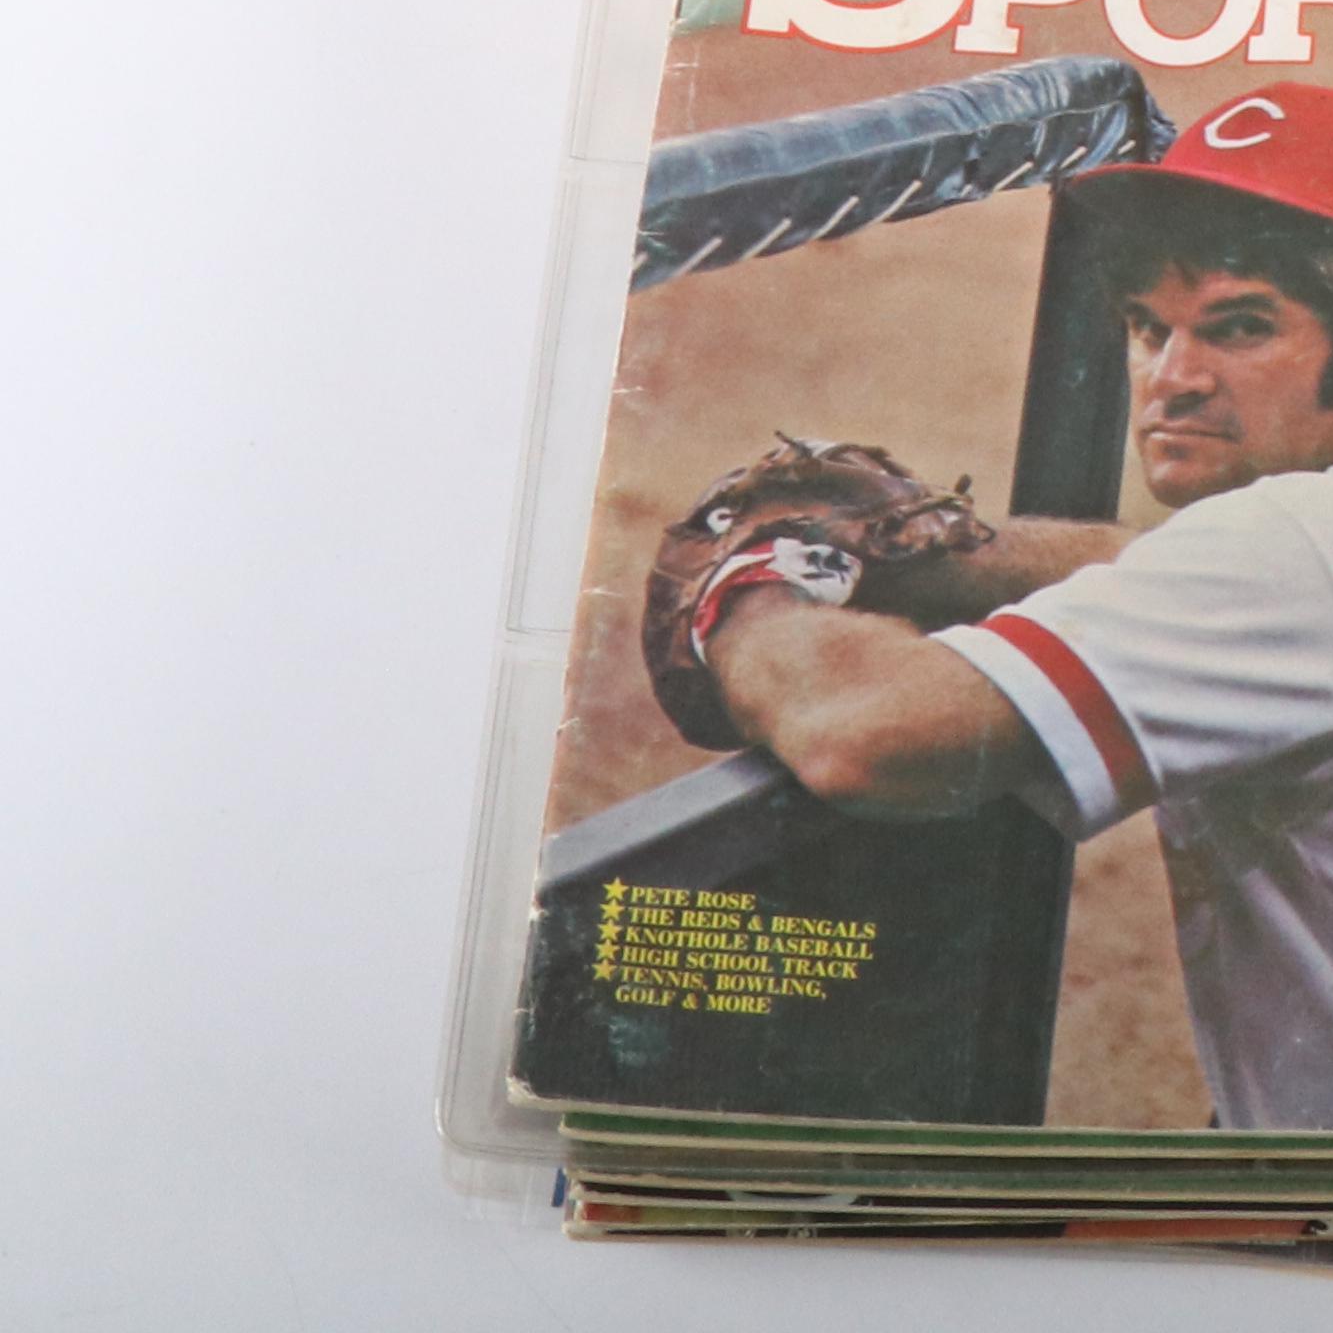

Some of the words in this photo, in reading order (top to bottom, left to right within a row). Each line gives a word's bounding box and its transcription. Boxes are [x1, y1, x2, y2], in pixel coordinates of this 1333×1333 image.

[1203, 98, 1286, 149] C
[630, 885, 690, 907] PETE
[698, 891, 756, 911] ROSE
[629, 906, 674, 925] THE
[681, 910, 740, 930] REDS
[771, 917, 877, 940] BENGALS
[626, 926, 748, 951] KNOTHOLE
[755, 933, 874, 960] BASEBALL
[621, 946, 679, 967] HIGH
[686, 951, 774, 973] SCHOOL
[782, 957, 858, 980] TRACK
[620, 966, 708, 991] TENNIS,
[715, 972, 827, 1000] BOWLING,
[615, 988, 675, 1007] GOLF
[706, 994, 772, 1015] MORE
